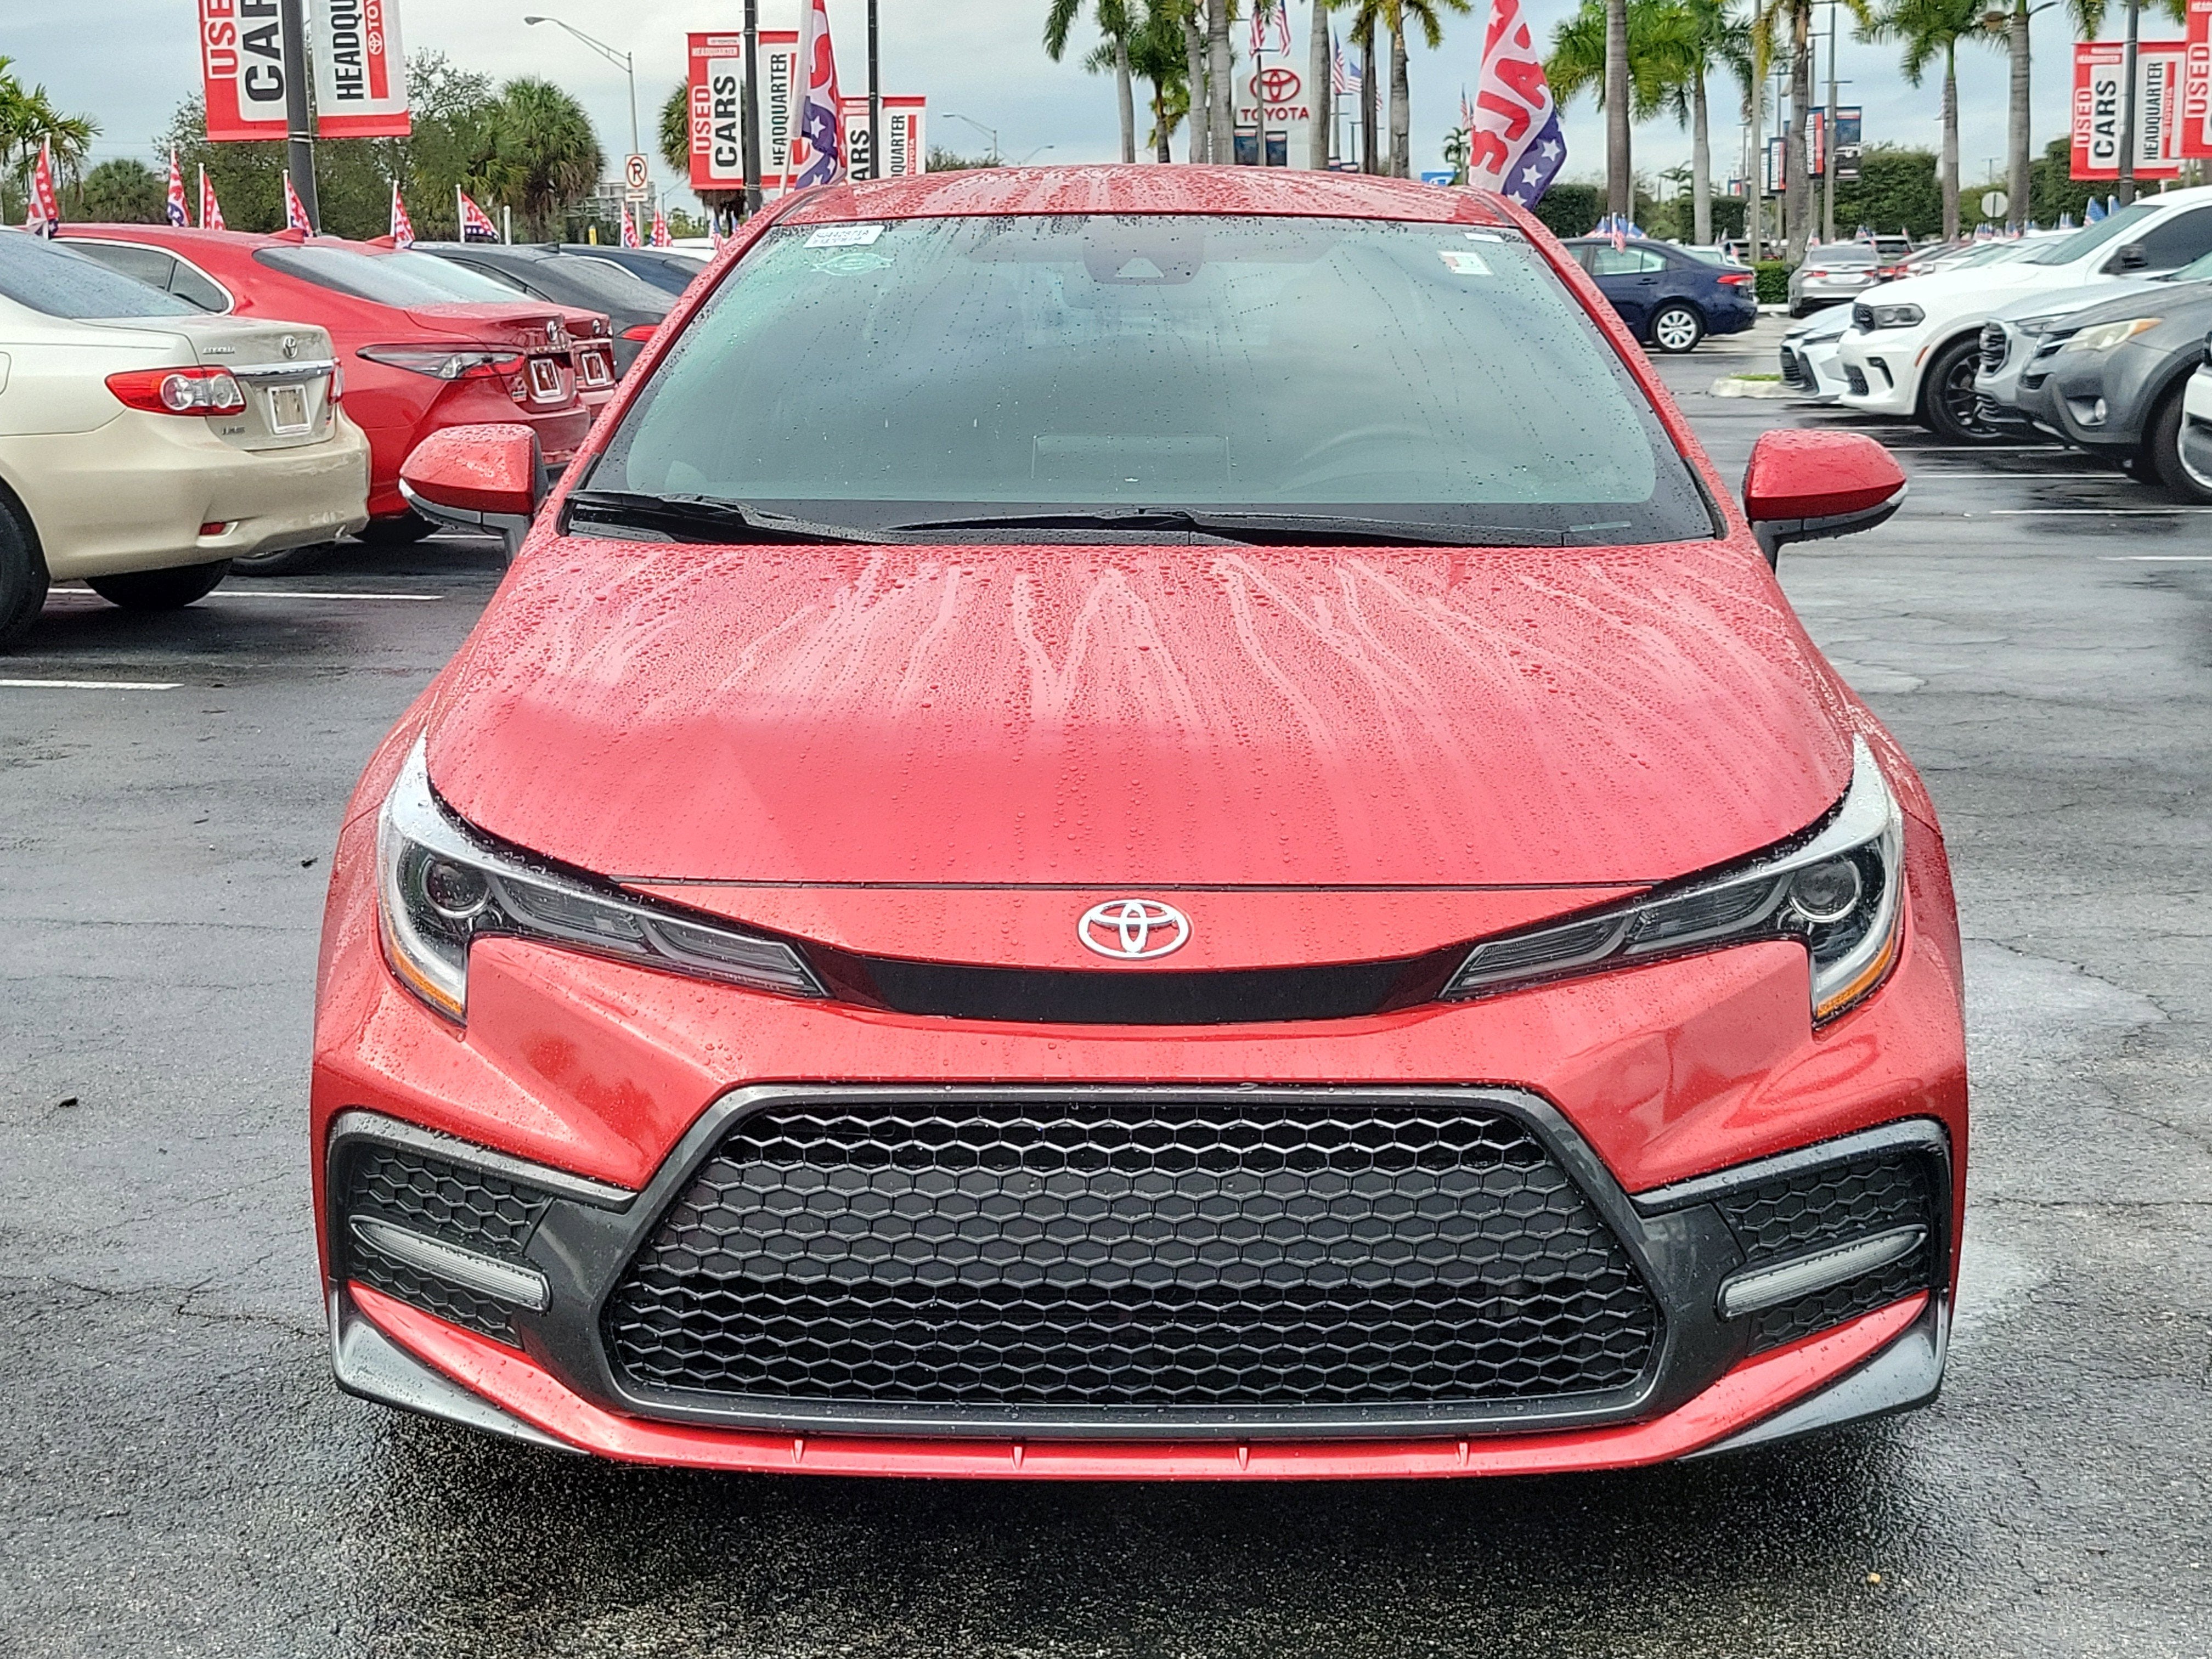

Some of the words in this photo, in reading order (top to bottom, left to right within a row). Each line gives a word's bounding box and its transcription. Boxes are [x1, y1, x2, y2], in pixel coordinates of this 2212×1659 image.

[207, 0, 238, 76] USE
[330, 0, 363, 100] HEADQU
[1241, 107, 1309, 121] TOYOTA
[2075, 91, 2091, 144] USED
[2143, 61, 2163, 160] HEADQUARTER
[2188, 46, 2209, 114] USED
[694, 87, 712, 152] USED
[713, 76, 737, 167] CARS
[2094, 81, 2116, 157] CARS
